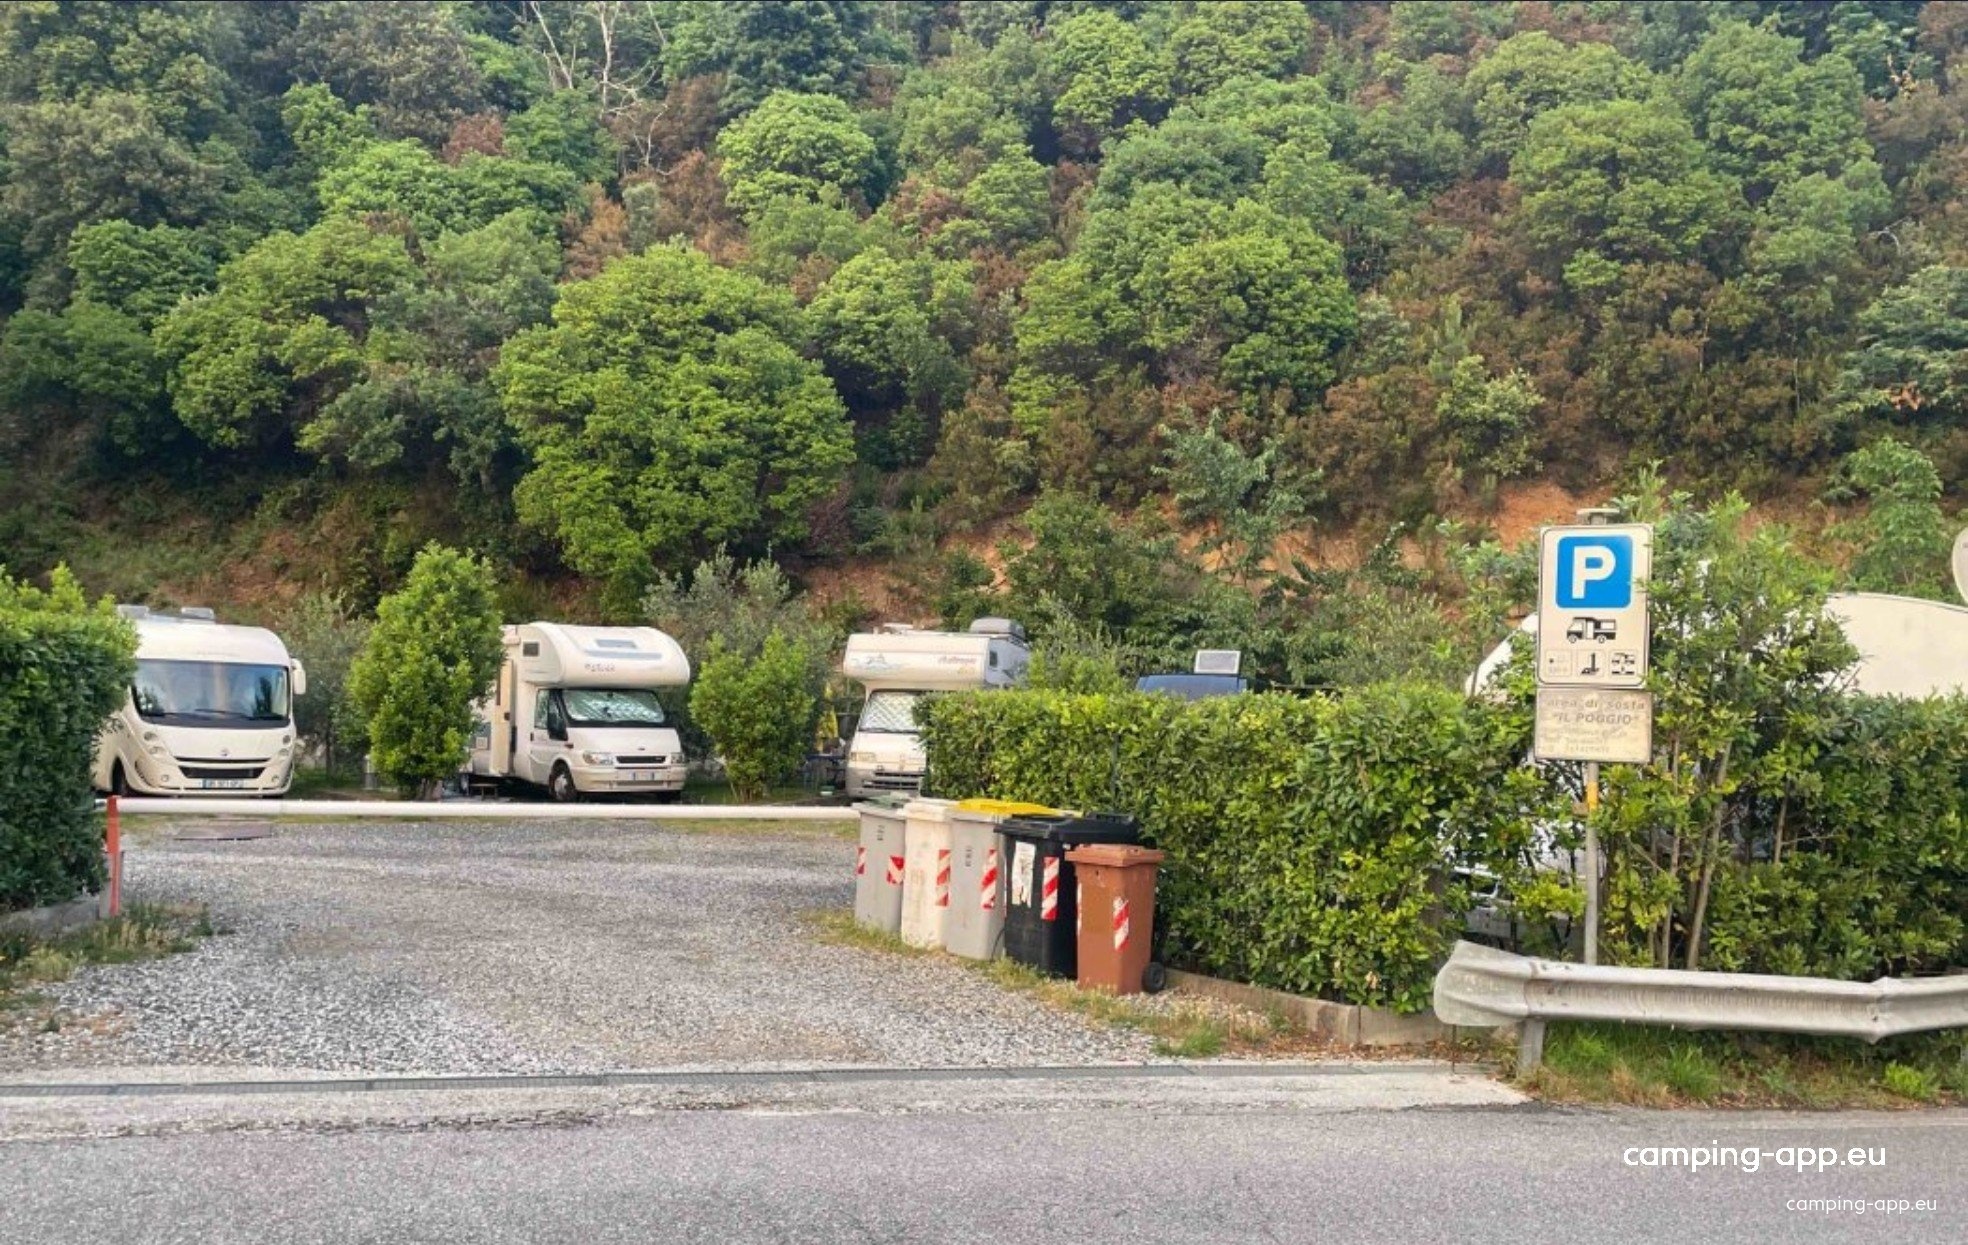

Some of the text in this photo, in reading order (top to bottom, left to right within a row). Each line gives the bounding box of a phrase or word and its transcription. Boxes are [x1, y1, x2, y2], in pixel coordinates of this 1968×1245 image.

[1572, 545, 1616, 599] P
[1585, 698, 1598, 708] di
[1607, 700, 1645, 711] sosta
